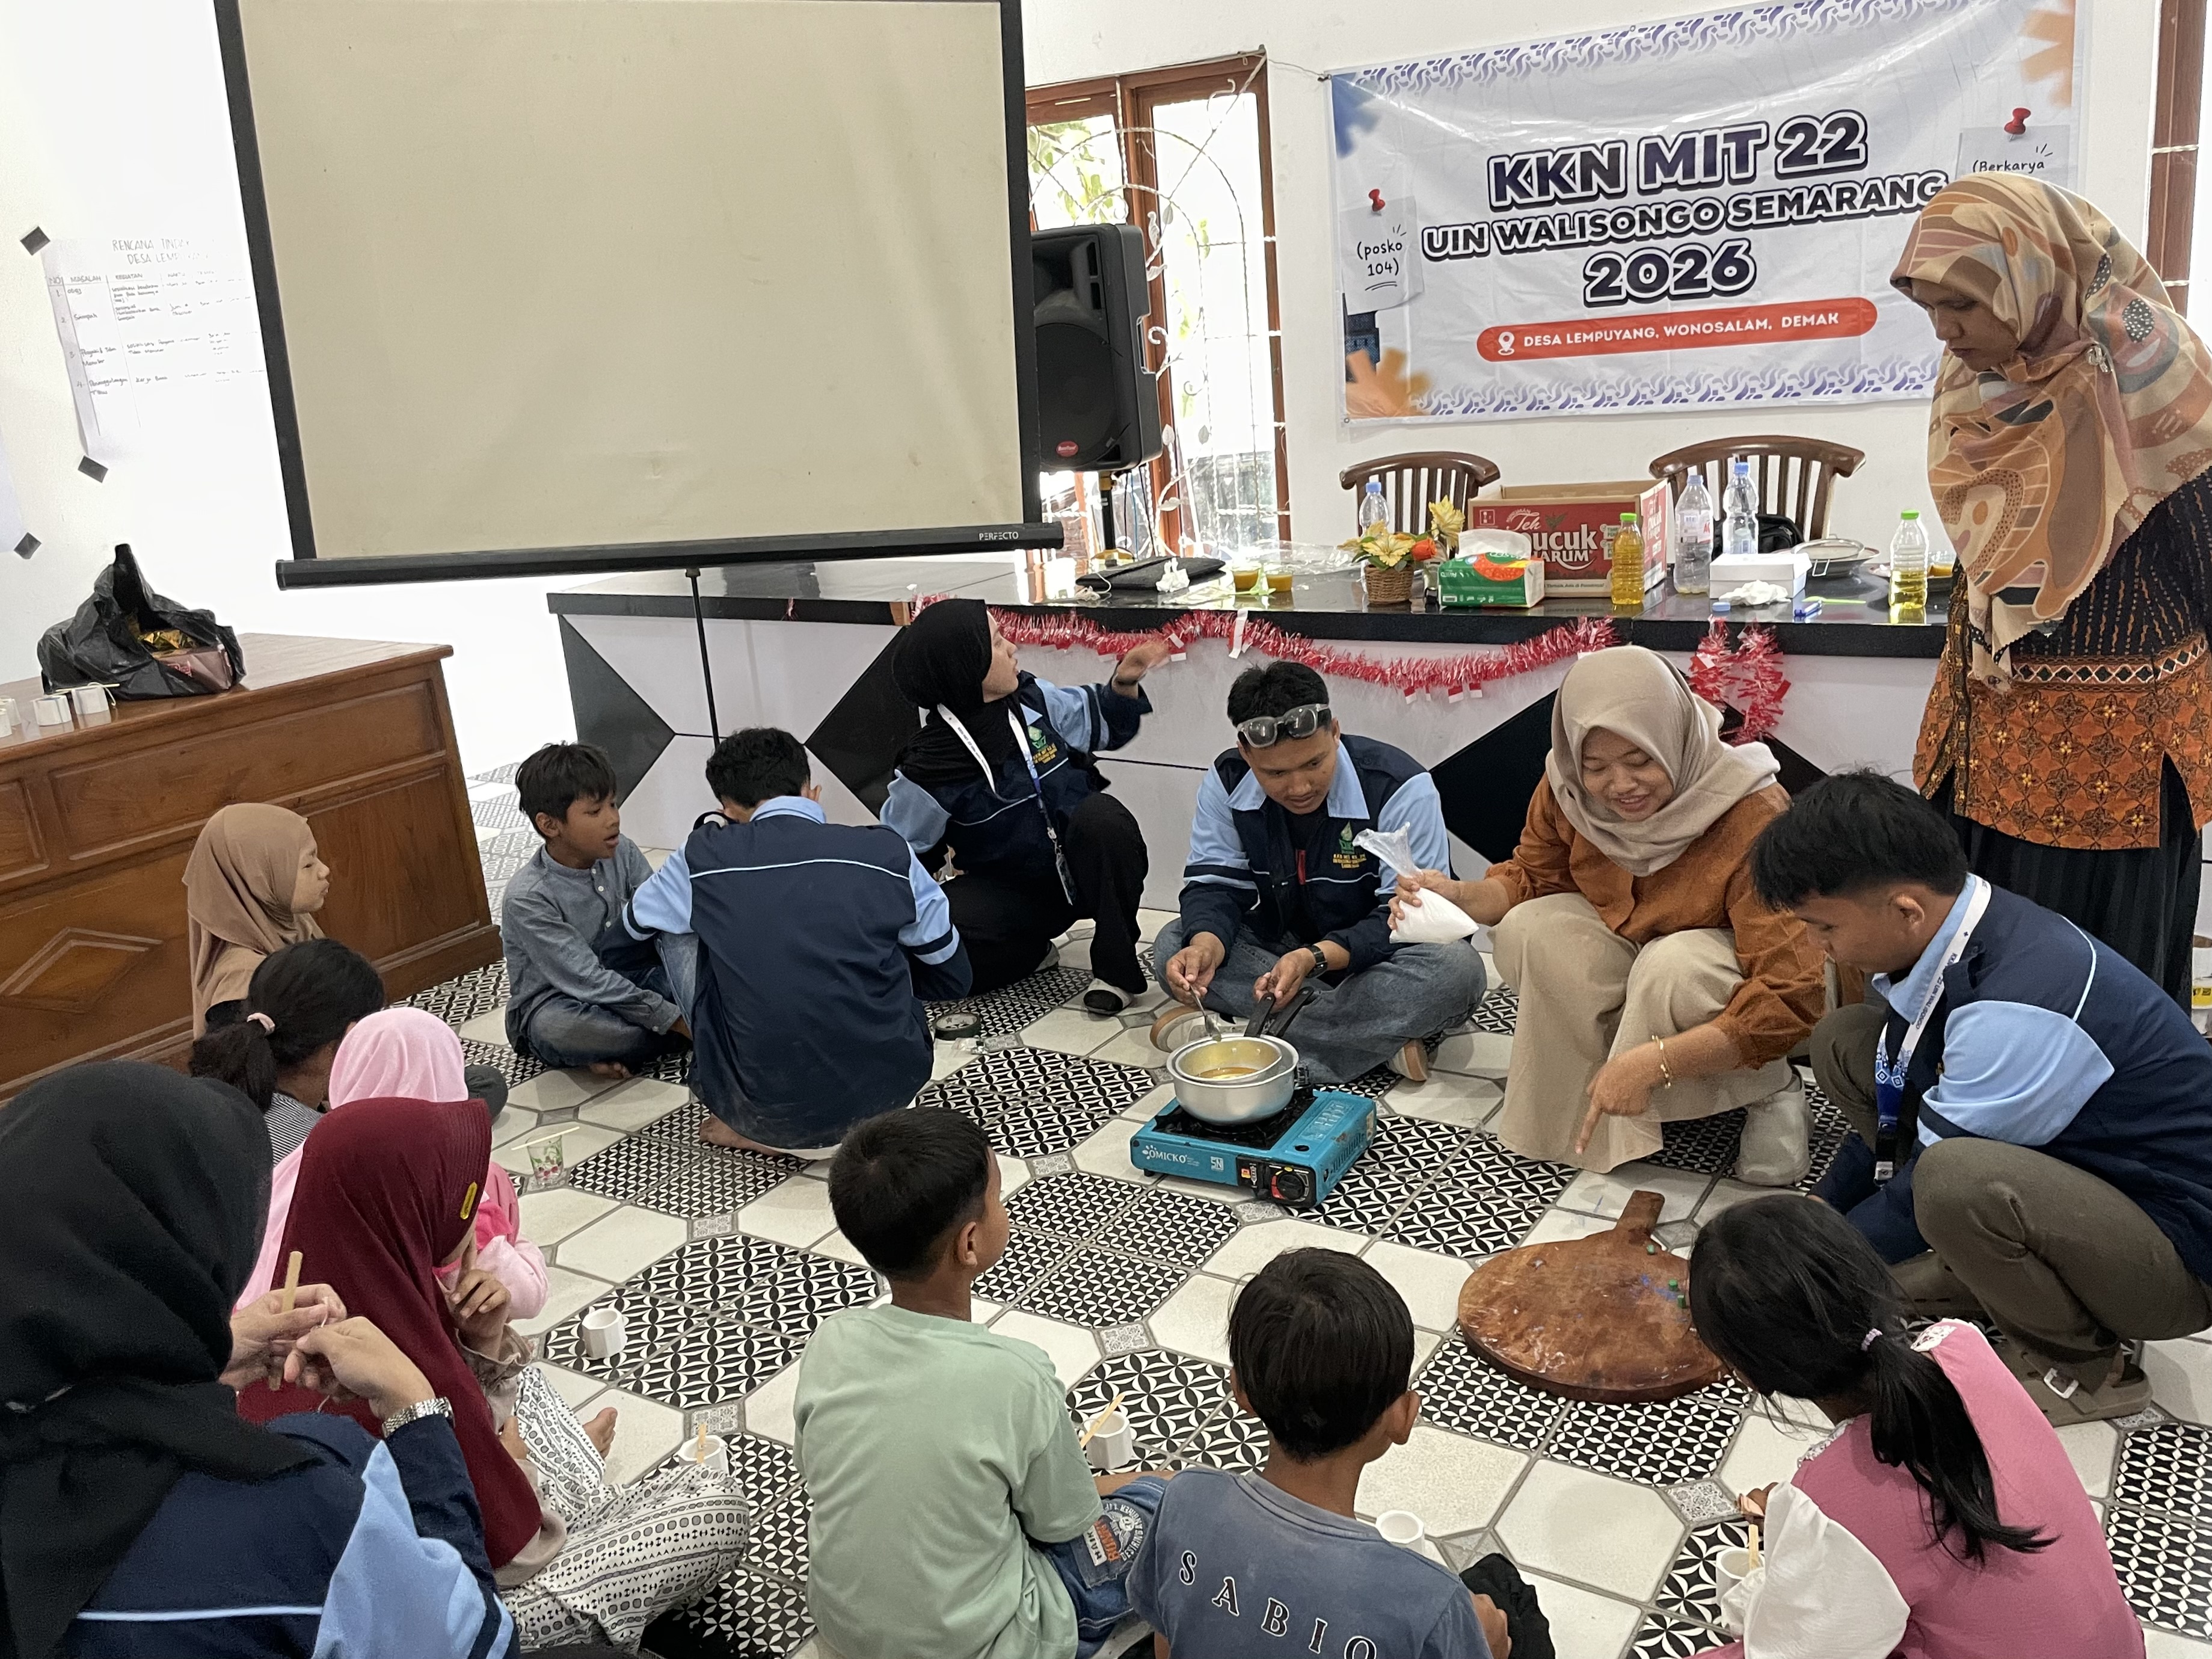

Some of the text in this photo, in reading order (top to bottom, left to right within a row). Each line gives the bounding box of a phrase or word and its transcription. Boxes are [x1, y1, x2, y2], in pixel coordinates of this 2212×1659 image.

[1488, 109, 1867, 212] KKN MIT 22
[1973, 159, 2045, 174] (Berkarya
[1422, 170, 1949, 262] UIN WALISONGO SEMARANG
[1357, 239, 1402, 260] (posko
[1367, 257, 1399, 277] 104)
[1584, 238, 1756, 308] 2026
[1523, 334, 1562, 347] DESA
[1781, 312, 1839, 328] DEMAK
[1507, 512, 1541, 531] Teh
[979, 531, 1019, 541] PERFECTO
[1524, 524, 1598, 550] ucuk
[1149, 1149, 1186, 1164] OMICKO
